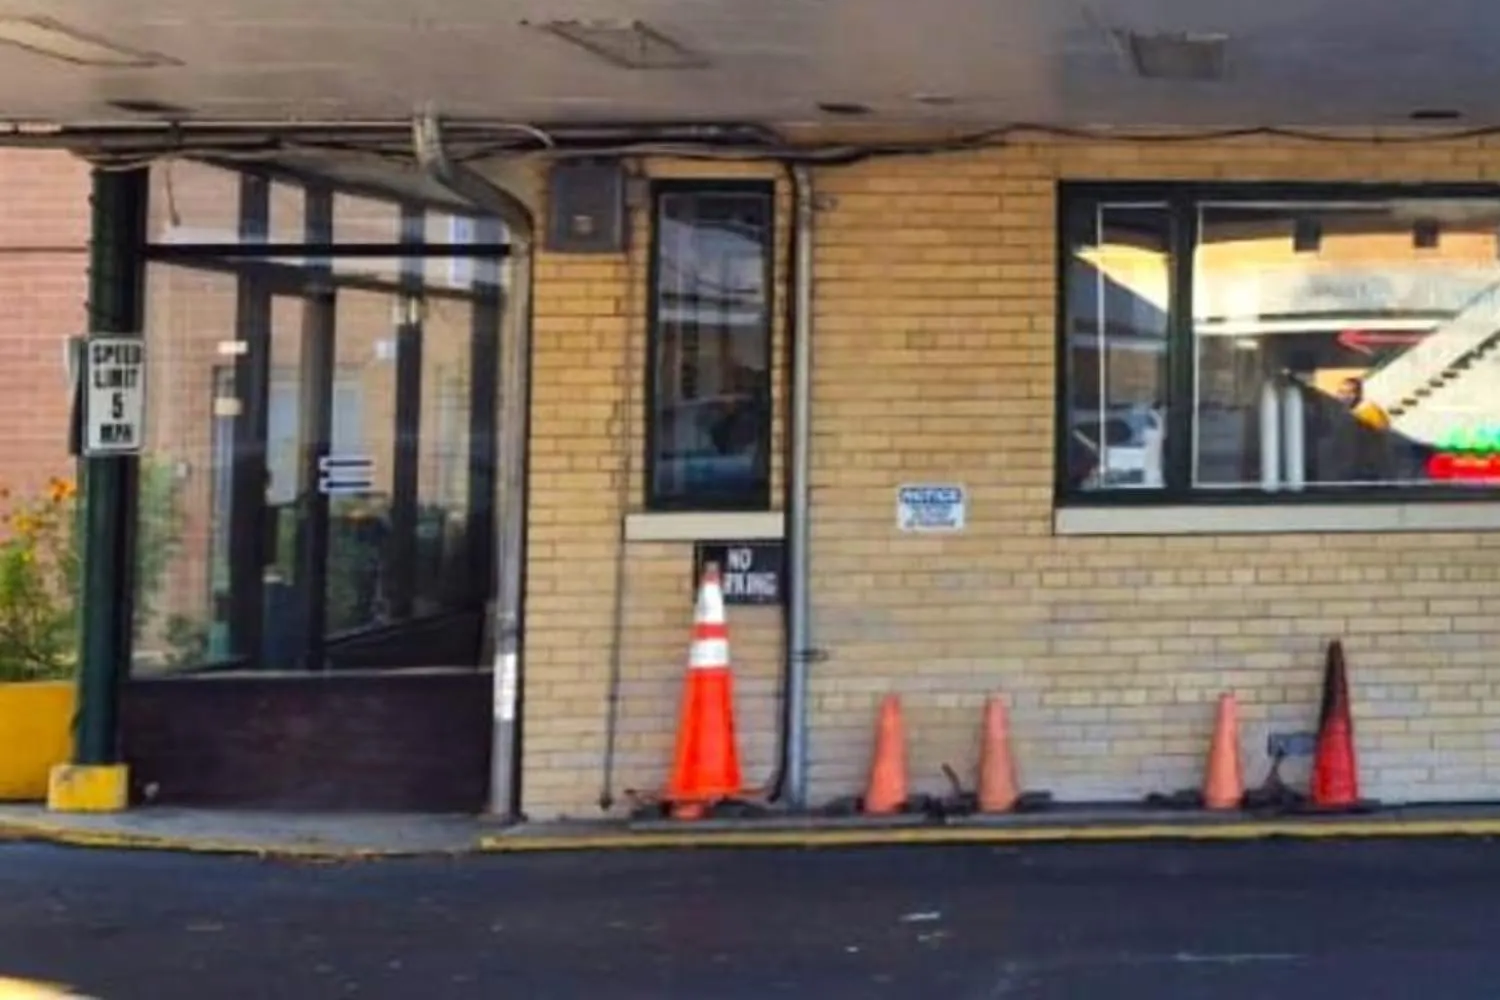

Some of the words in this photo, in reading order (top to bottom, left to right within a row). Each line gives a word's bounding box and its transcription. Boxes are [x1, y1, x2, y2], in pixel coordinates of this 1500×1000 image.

[93, 343, 142, 365] SPEED
[94, 368, 138, 389] LIMIT
[111, 392, 124, 419] 5
[100, 423, 134, 443] MPH
[727, 549, 753, 571] NO
[723, 572, 777, 596] RKING
